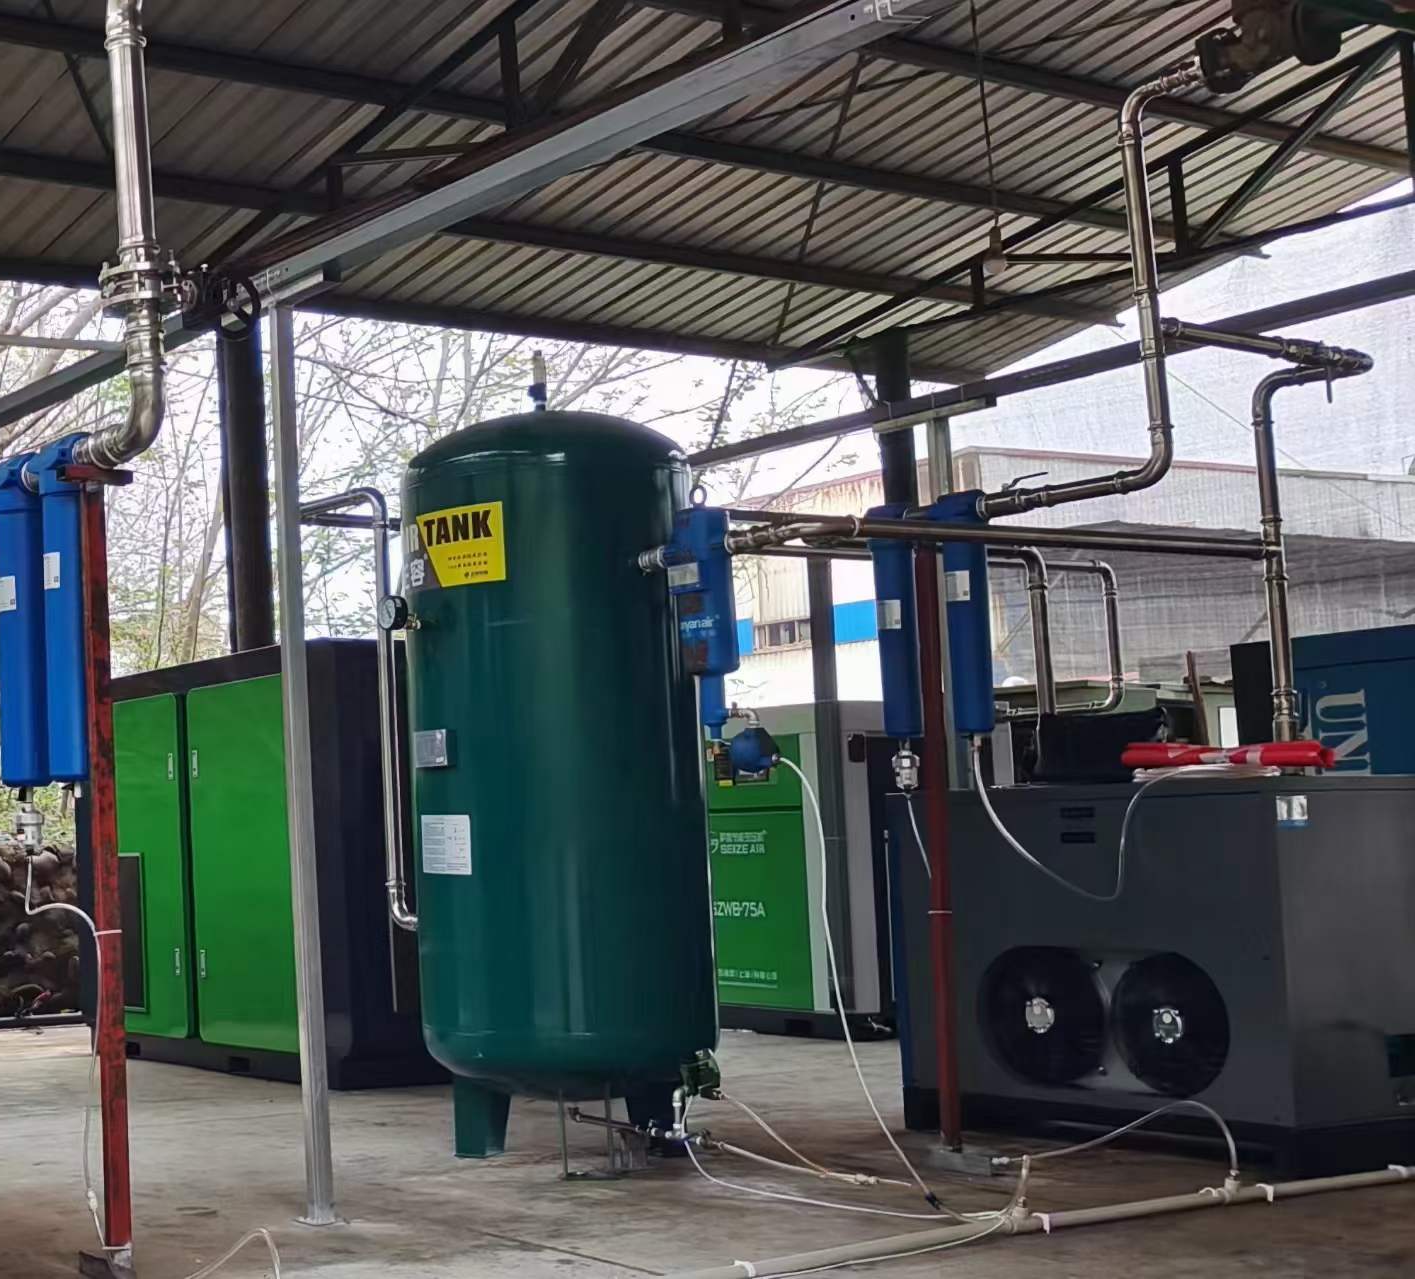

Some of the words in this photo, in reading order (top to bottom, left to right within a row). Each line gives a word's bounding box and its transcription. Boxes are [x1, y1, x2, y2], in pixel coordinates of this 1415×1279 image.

[423, 509, 493, 547] TANK
[720, 843, 749, 854] SEIZE
[749, 843, 765, 854] AIR
